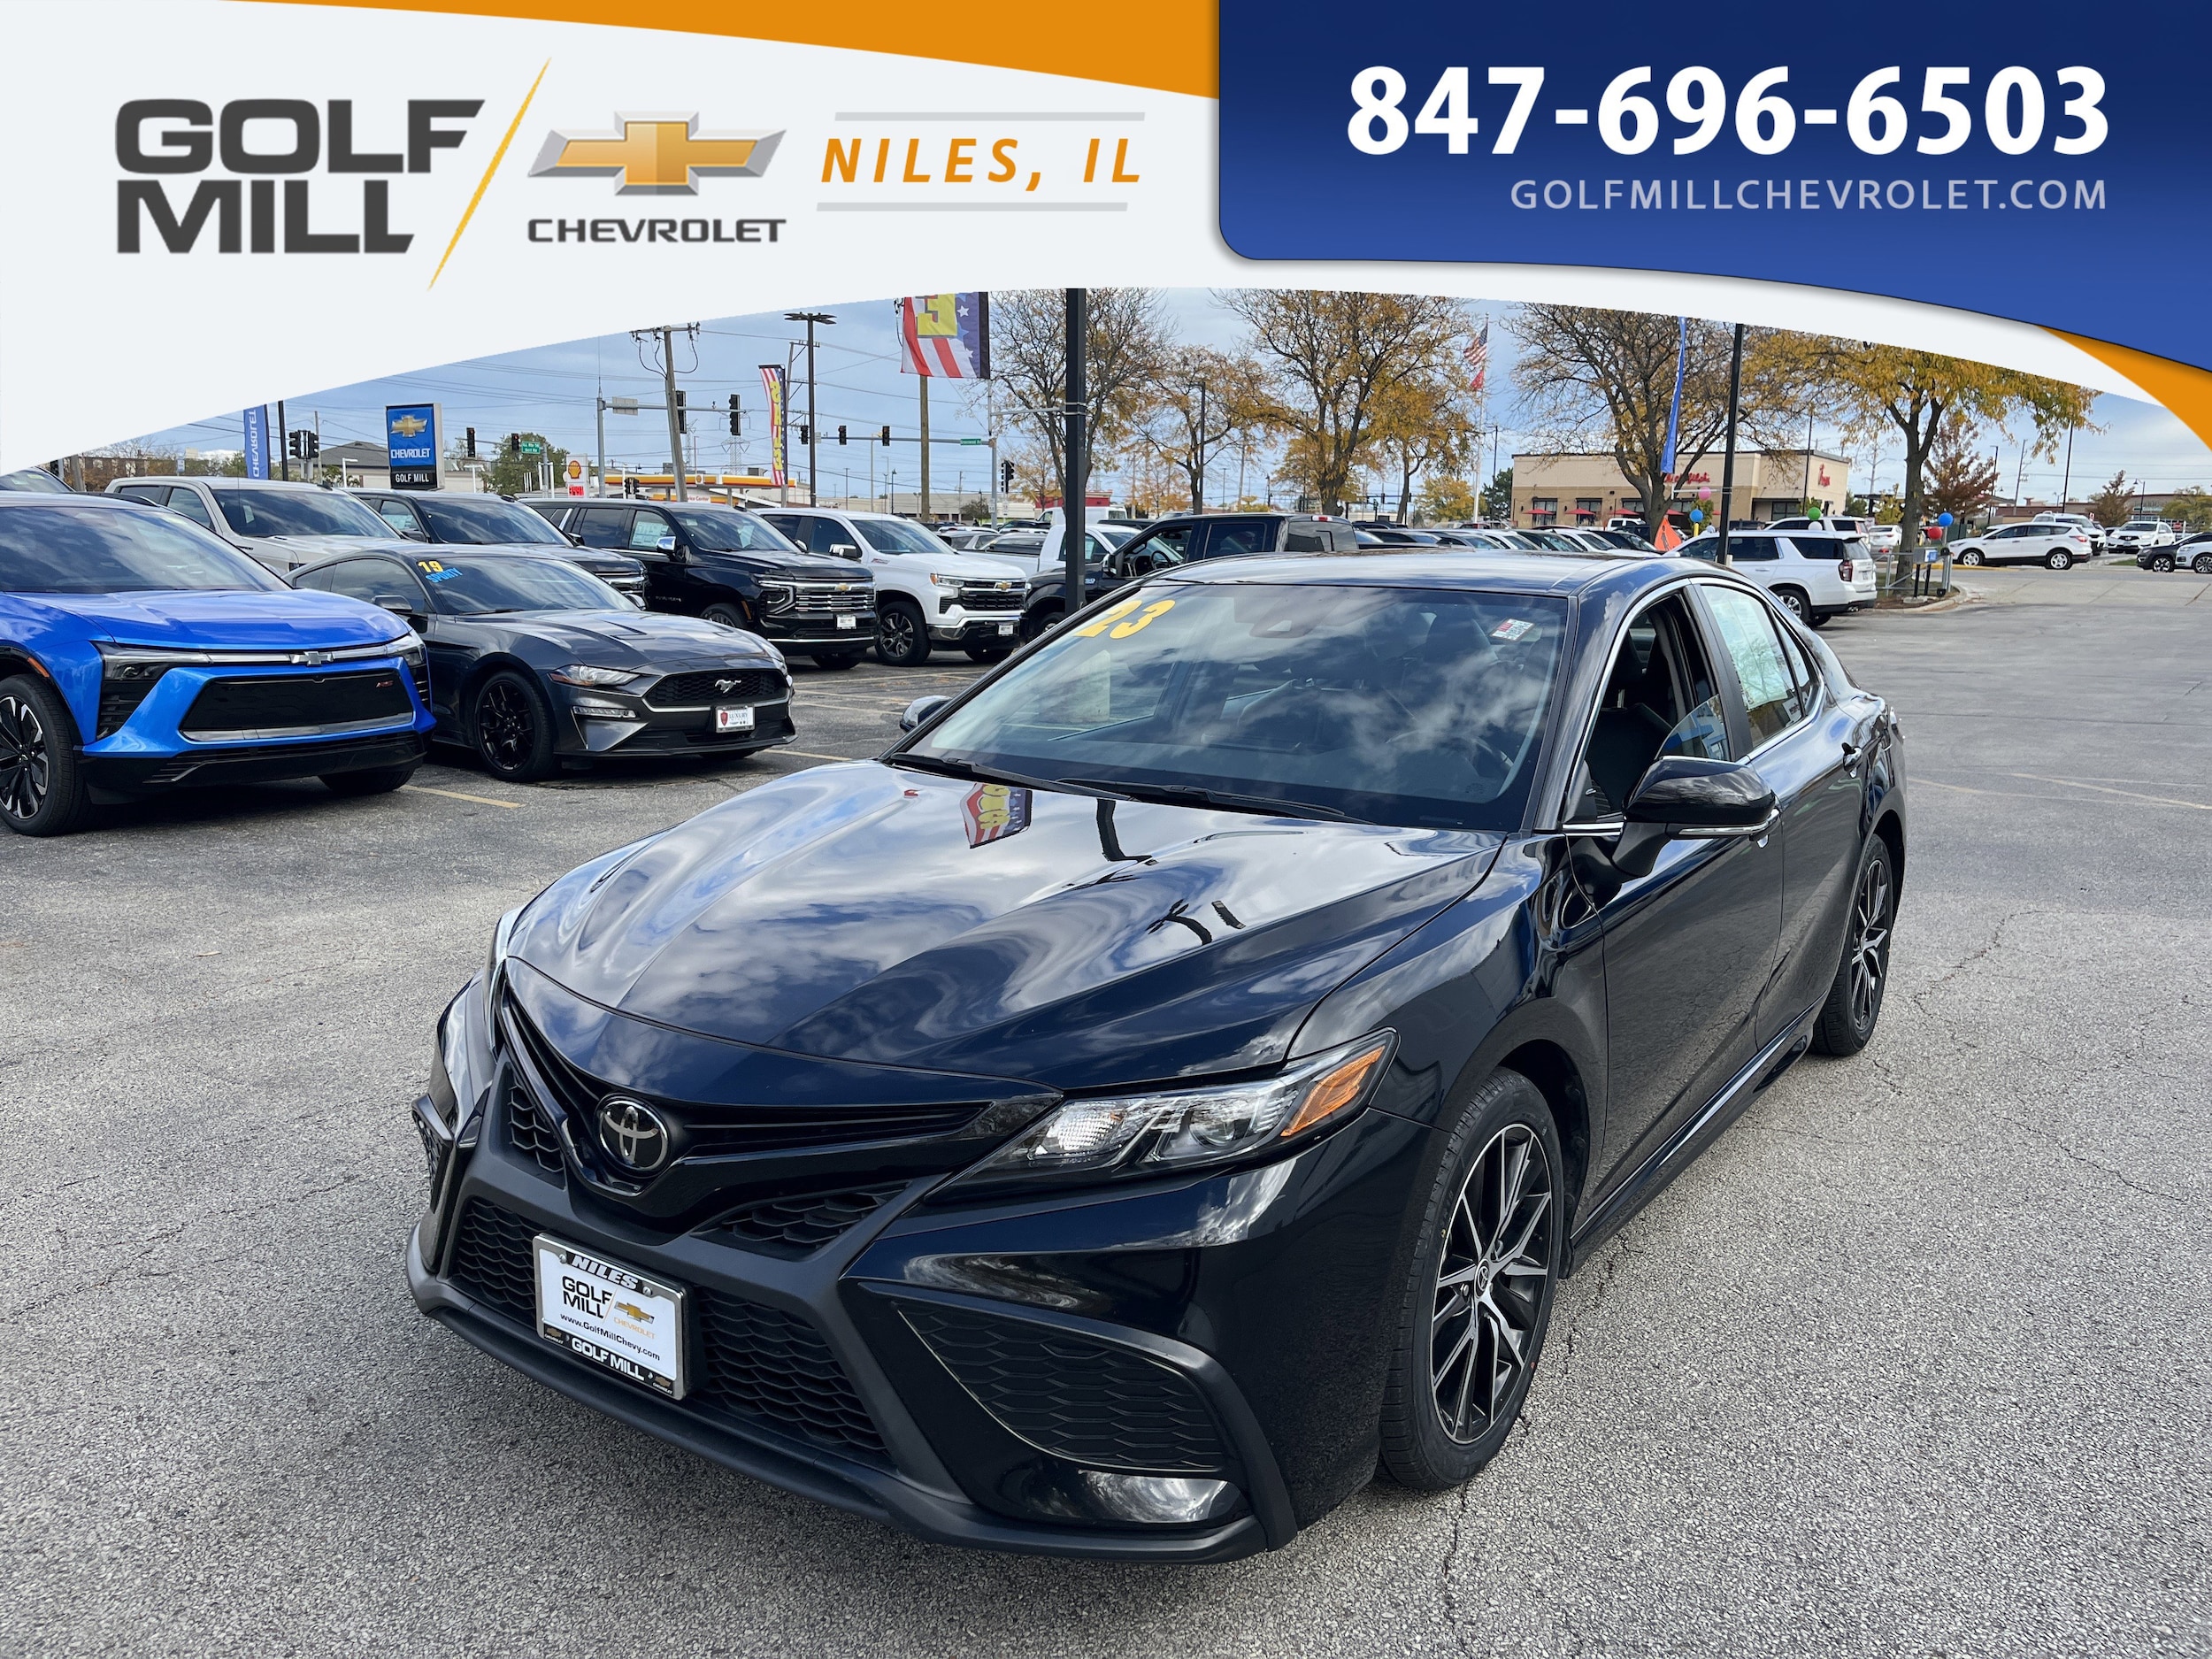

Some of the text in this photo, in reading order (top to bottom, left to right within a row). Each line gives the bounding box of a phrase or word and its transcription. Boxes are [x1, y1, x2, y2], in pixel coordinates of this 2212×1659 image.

[390, 448, 431, 459] CHEVROLET
[395, 473, 430, 483] GOLF MILL
[418, 560, 445, 573] 19
[425, 567, 464, 583] SPORTY
[1072, 599, 1177, 640] 23
[571, 1255, 639, 1290] NILES
[562, 1275, 613, 1305] GOLF
[563, 1289, 604, 1319] MILL
[559, 1313, 661, 1362] www.GolfMillChevy.com
[613, 1316, 656, 1340] CHEVROLET
[571, 1337, 645, 1381] GOLF MILL
